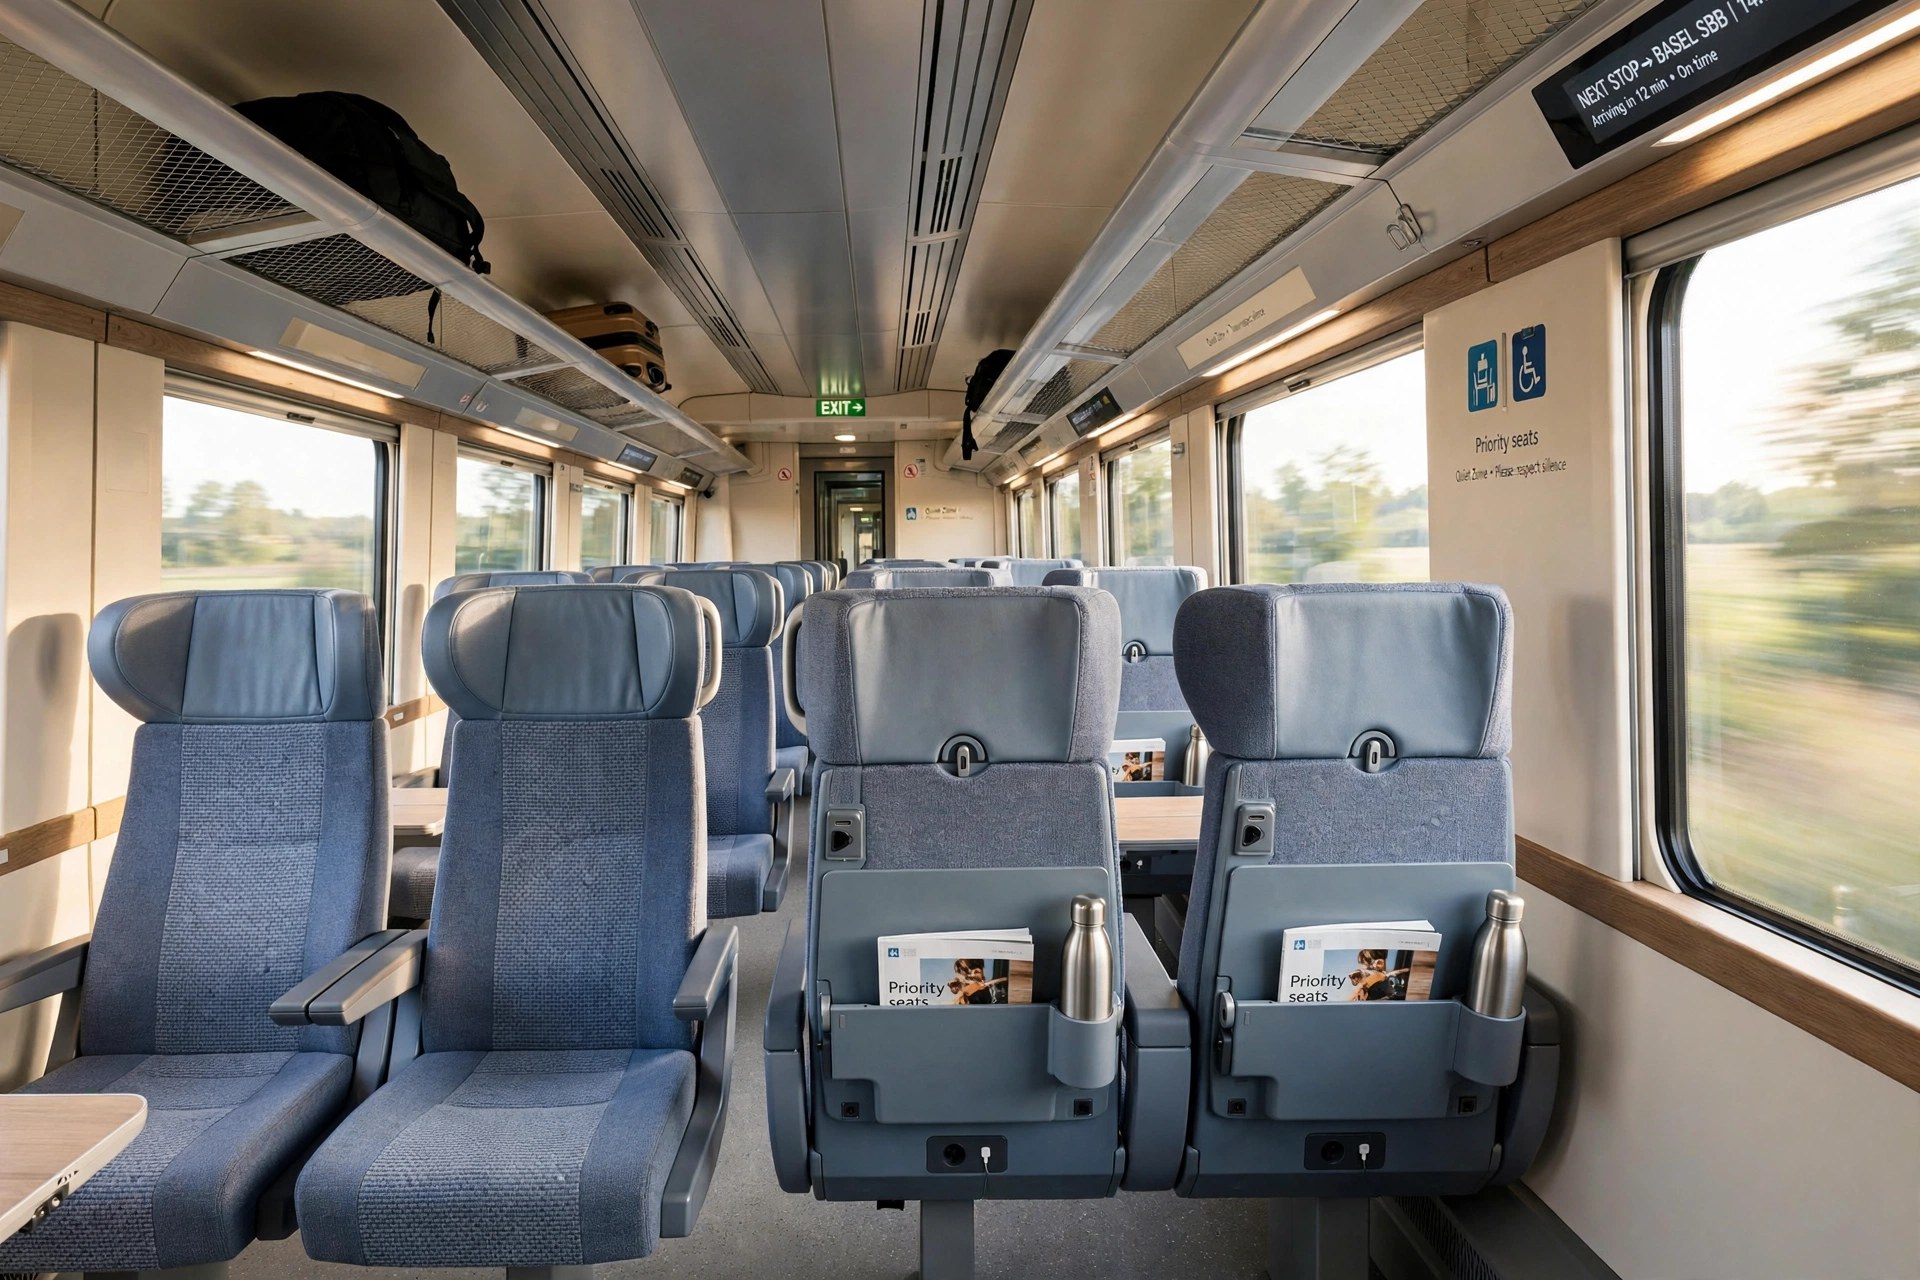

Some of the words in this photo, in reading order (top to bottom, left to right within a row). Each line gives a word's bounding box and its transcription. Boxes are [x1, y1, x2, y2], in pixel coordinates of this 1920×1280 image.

[1577, 79, 1609, 109] NEXT
[1607, 60, 1640, 90] STOP
[1651, 28, 1699, 64] BASEL
[1696, 8, 1728, 38] SBB
[1592, 102, 1628, 128] Arriving
[1623, 96, 1637, 109] in
[1635, 86, 1651, 102] 12
[1649, 78, 1669, 95] min
[1676, 64, 1694, 78] On
[1692, 50, 1719, 70] time
[821, 400, 851, 415] EXIT
[1475, 434, 1509, 454] Priority
[1512, 429, 1539, 448] seats
[889, 981, 945, 997] Priority
[1290, 974, 1347, 990] Priority
[889, 997, 929, 1006] seats
[1289, 991, 1329, 1003] seats
